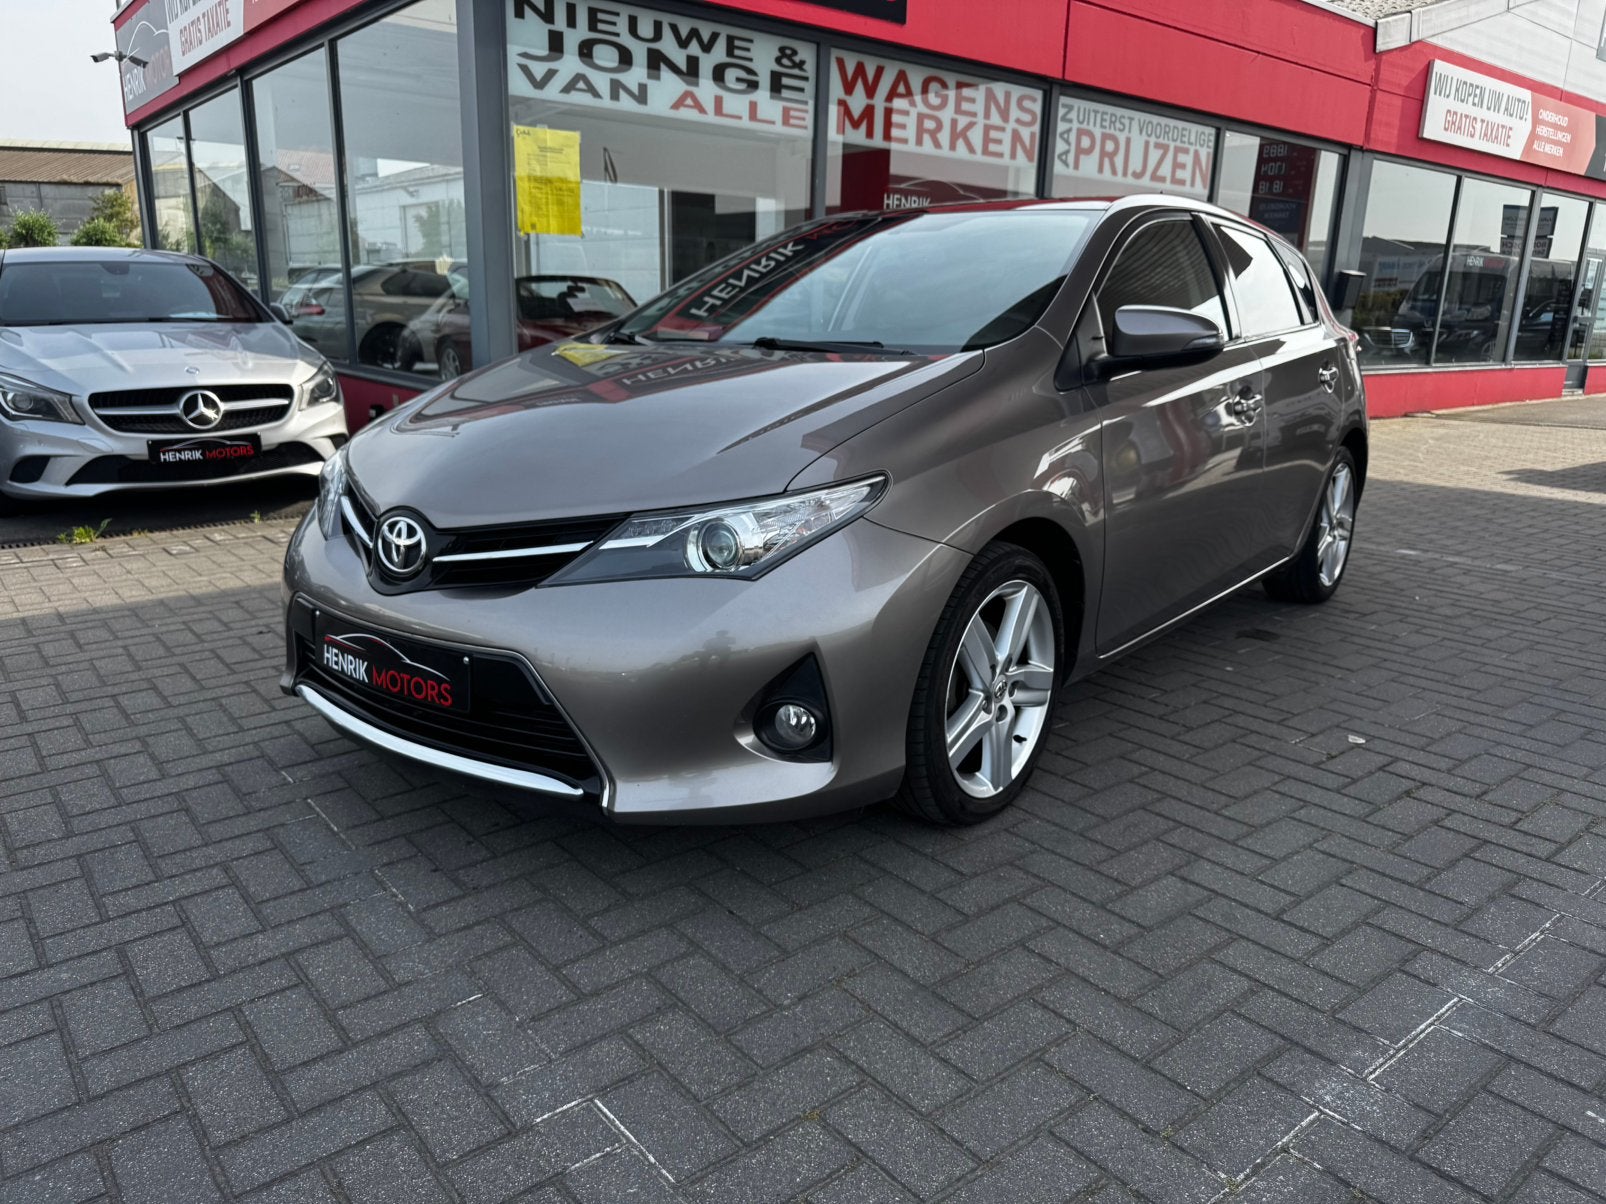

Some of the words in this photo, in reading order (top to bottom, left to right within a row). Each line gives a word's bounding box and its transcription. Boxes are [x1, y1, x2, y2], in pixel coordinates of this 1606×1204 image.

[180, 16, 203, 57] GRATIS
[514, 0, 754, 62] NIEUWE
[774, 46, 807, 73] &
[517, 29, 809, 104] JONGE
[516, 63, 648, 106] VAN
[670, 90, 809, 130] ALLE
[835, 56, 1038, 128] WAGENS
[1433, 71, 1454, 97] WIJ
[1453, 79, 1487, 109] KOPEN
[1486, 88, 1505, 114] UW
[1503, 95, 1530, 122] AUTO!
[835, 98, 1037, 164] MERKEN
[1057, 103, 1074, 168] AAN
[1073, 127, 1211, 190] PRIJZEN
[1076, 106, 1135, 133] UITERST
[1138, 118, 1214, 149] VOORDELIGE
[1443, 109, 1477, 138] GRATIS
[1478, 118, 1513, 147] TAXATIE
[160, 449, 203, 463] HENRIK
[205, 445, 255, 459] MOTORS
[323, 644, 368, 683] HENRIK
[372, 664, 453, 707] MOTORS
